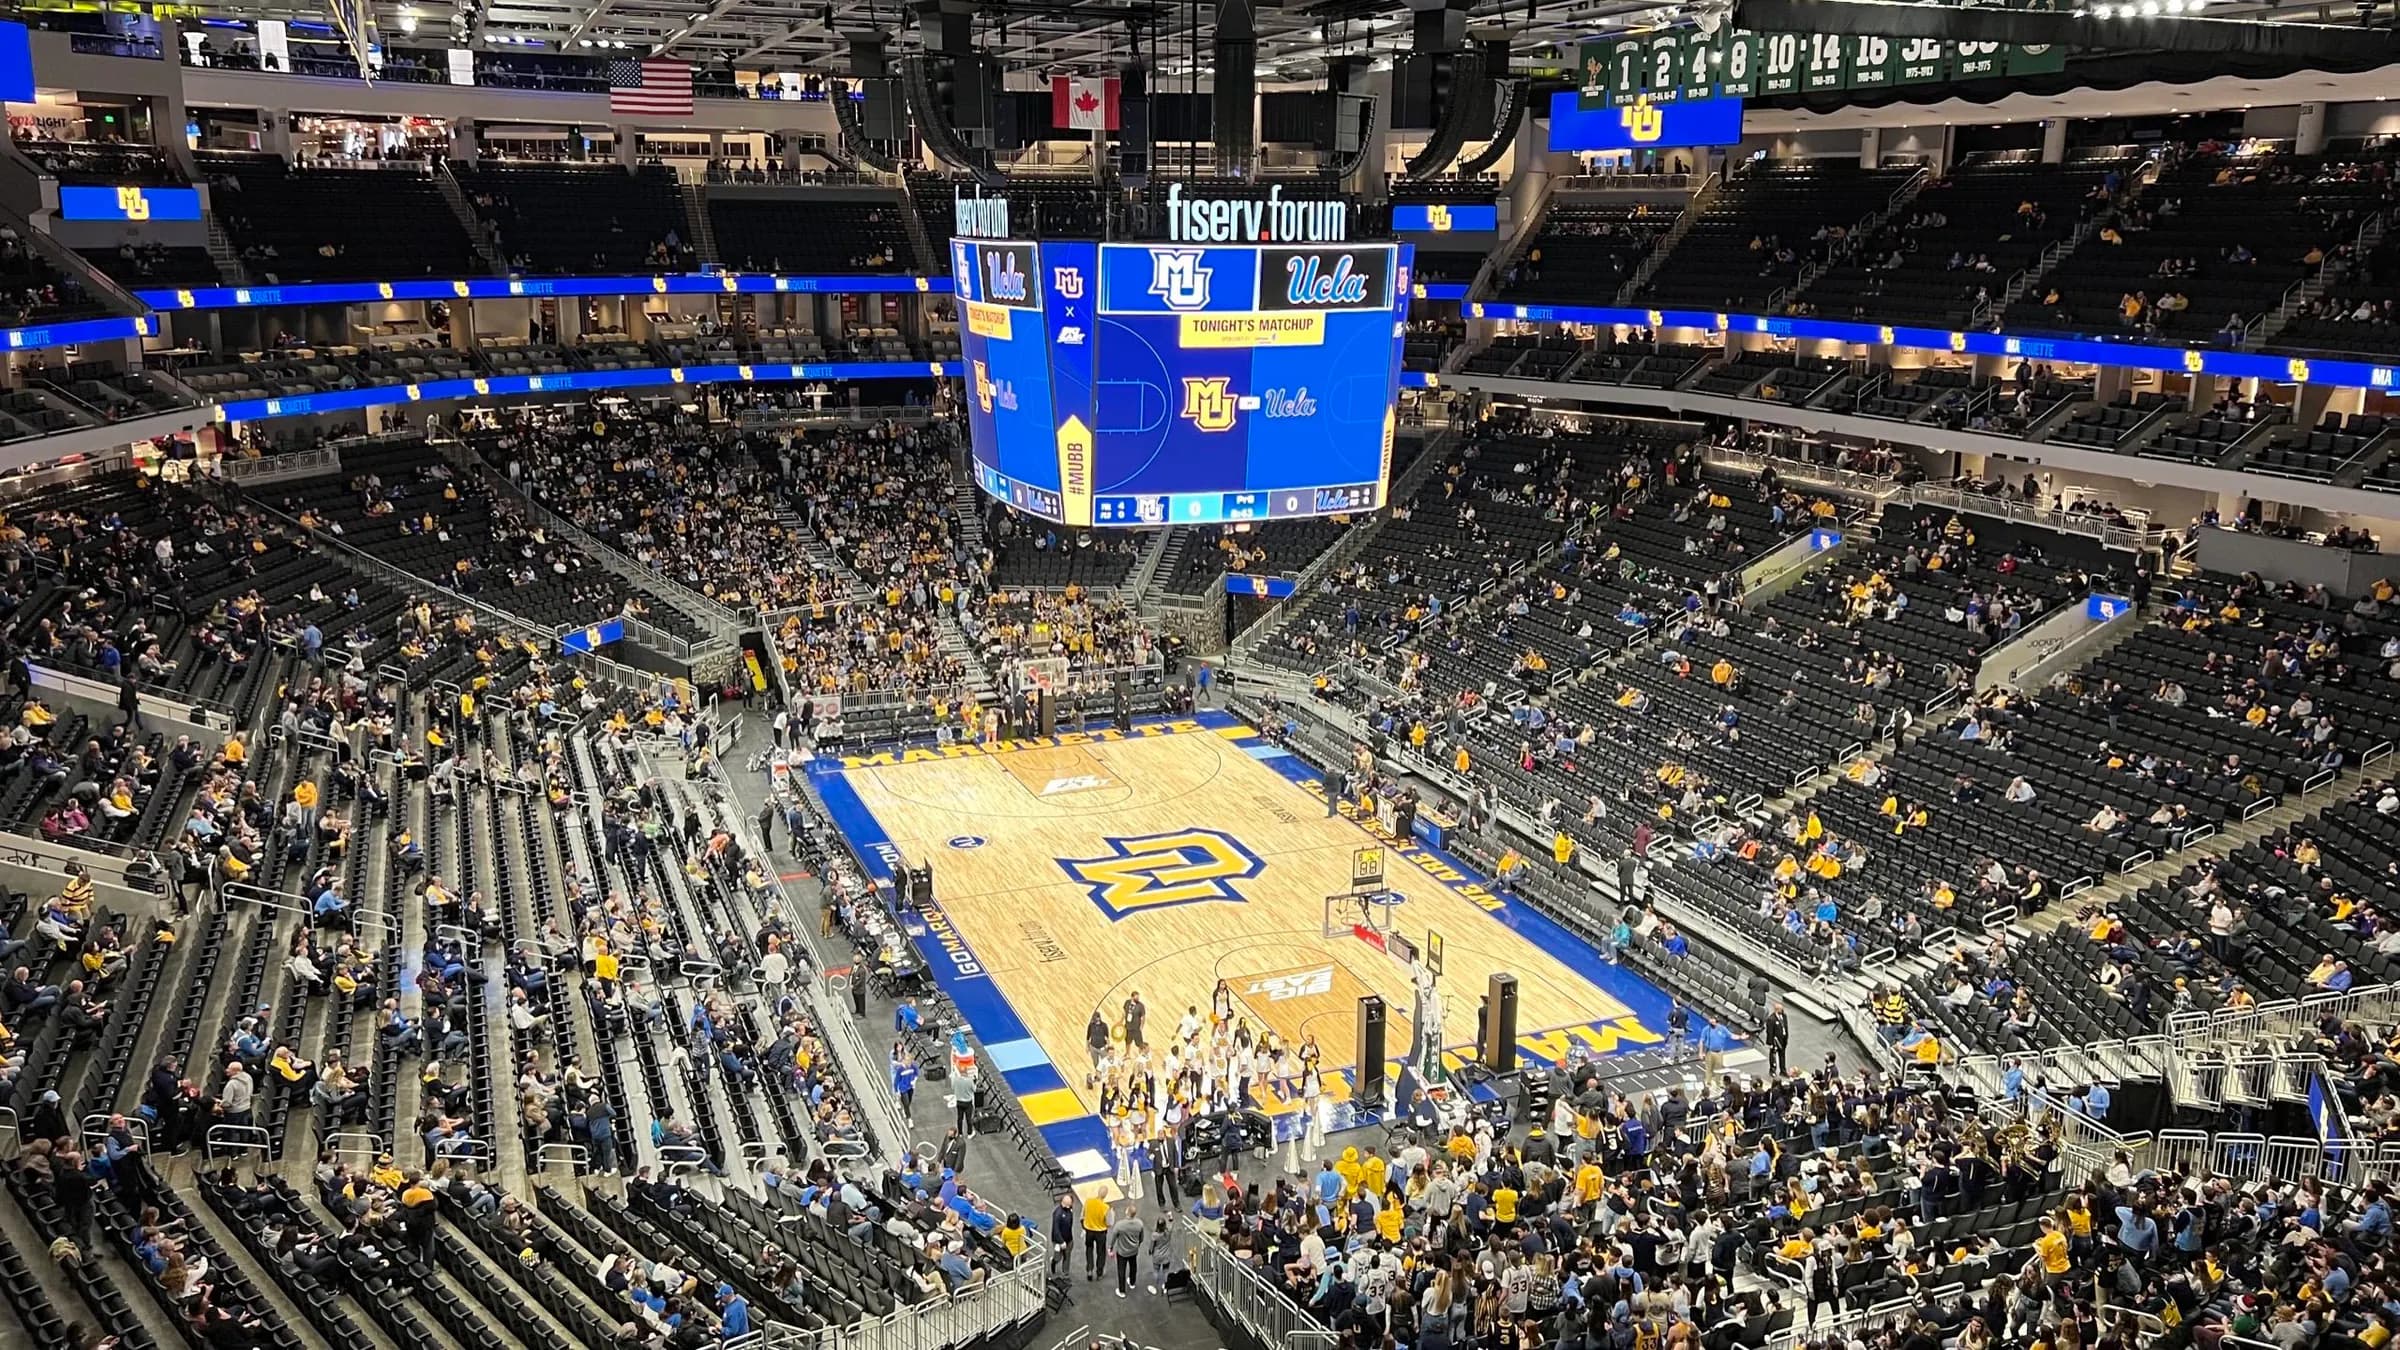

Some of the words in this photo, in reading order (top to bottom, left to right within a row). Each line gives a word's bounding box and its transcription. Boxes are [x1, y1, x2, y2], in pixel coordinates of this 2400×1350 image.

[1692, 47, 1706, 83] 4
[1731, 41, 1747, 79] 8
[1767, 34, 1795, 74] 10
[1811, 34, 1840, 70] 14
[1620, 56, 1629, 90] 1
[1655, 51, 1670, 87] 2
[36, 117, 66, 128] LIGHT
[117, 187, 149, 219] MU
[1167, 183, 1345, 242] fiserv.forum
[1428, 205, 1451, 230] MU
[1054, 268, 1083, 298] MU
[1148, 250, 1213, 311] MU
[1193, 319, 1255, 332] TONIGHT'S
[1259, 318, 1313, 332] MATCHUP
[1180, 377, 1239, 432] MU
[1067, 442, 1085, 496] #MUBB
[1286, 496, 1298, 512] 0
[1406, 852, 1467, 881] ARE
[1454, 883, 1507, 912] WE
[1369, 1284, 1386, 1298] 33
[1511, 1280, 1527, 1294] 33
